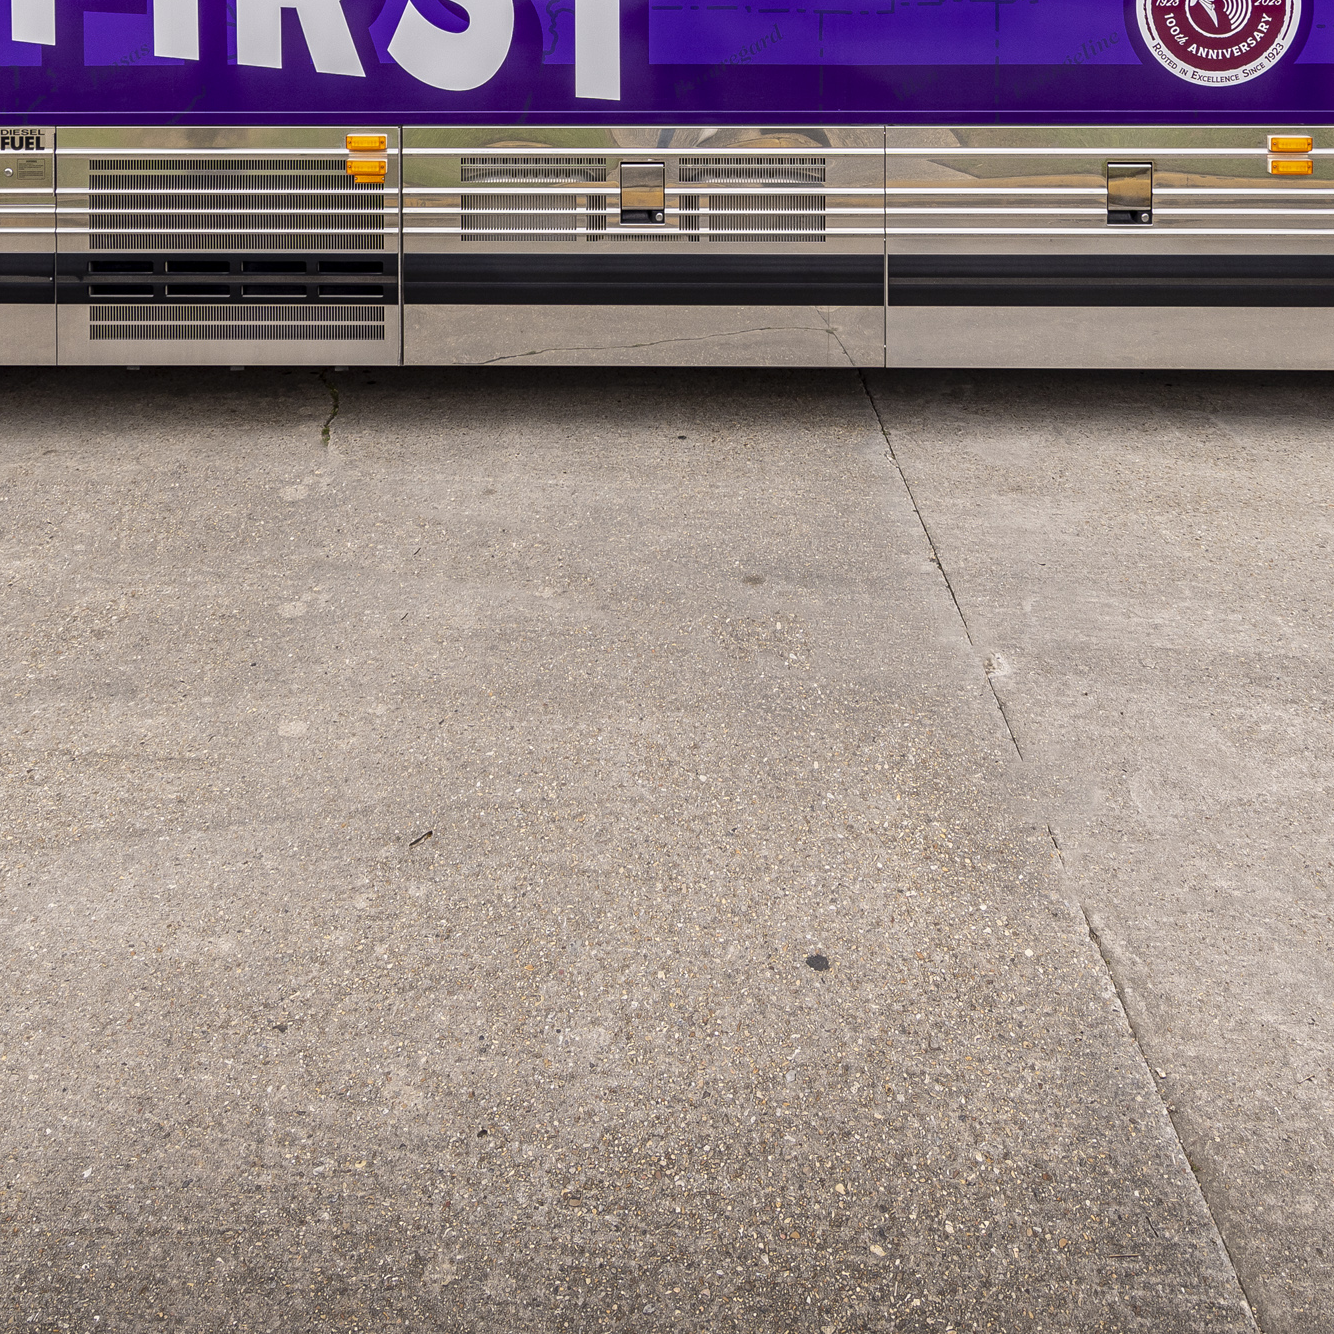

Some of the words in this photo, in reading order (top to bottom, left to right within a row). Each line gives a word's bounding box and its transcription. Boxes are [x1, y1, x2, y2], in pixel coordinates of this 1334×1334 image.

[1164, 13, 1189, 46] 100th
[1187, 13, 1273, 60] ANNIVERSARY
[1264, 42, 1285, 63] 1923
[0, 136, 46, 151] FUEL
